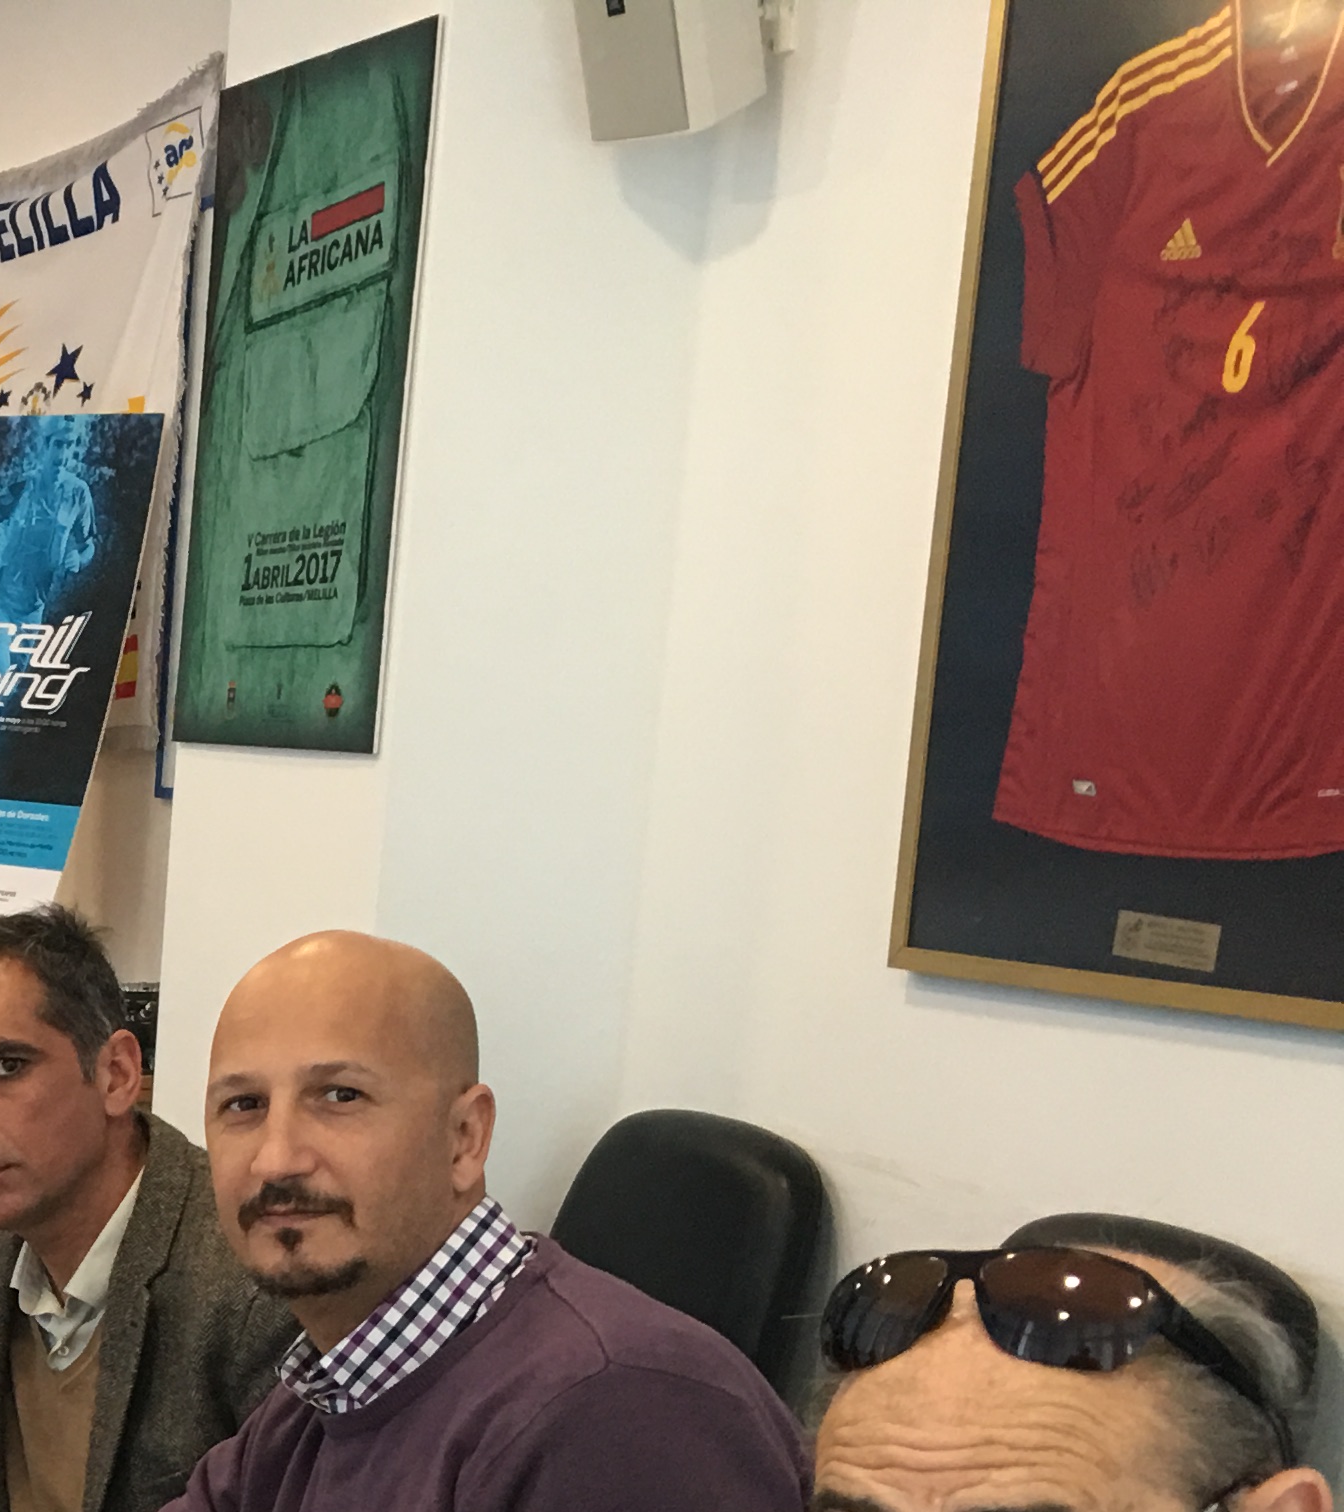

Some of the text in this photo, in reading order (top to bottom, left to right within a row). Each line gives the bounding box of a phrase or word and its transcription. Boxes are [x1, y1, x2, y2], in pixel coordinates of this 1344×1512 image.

[282, 226, 384, 291] AFRICANA
[288, 217, 309, 253] LA
[1221, 301, 1265, 393] 6
[255, 532, 286, 546] Carrera
[289, 527, 300, 541] de
[313, 521, 346, 541] Legión
